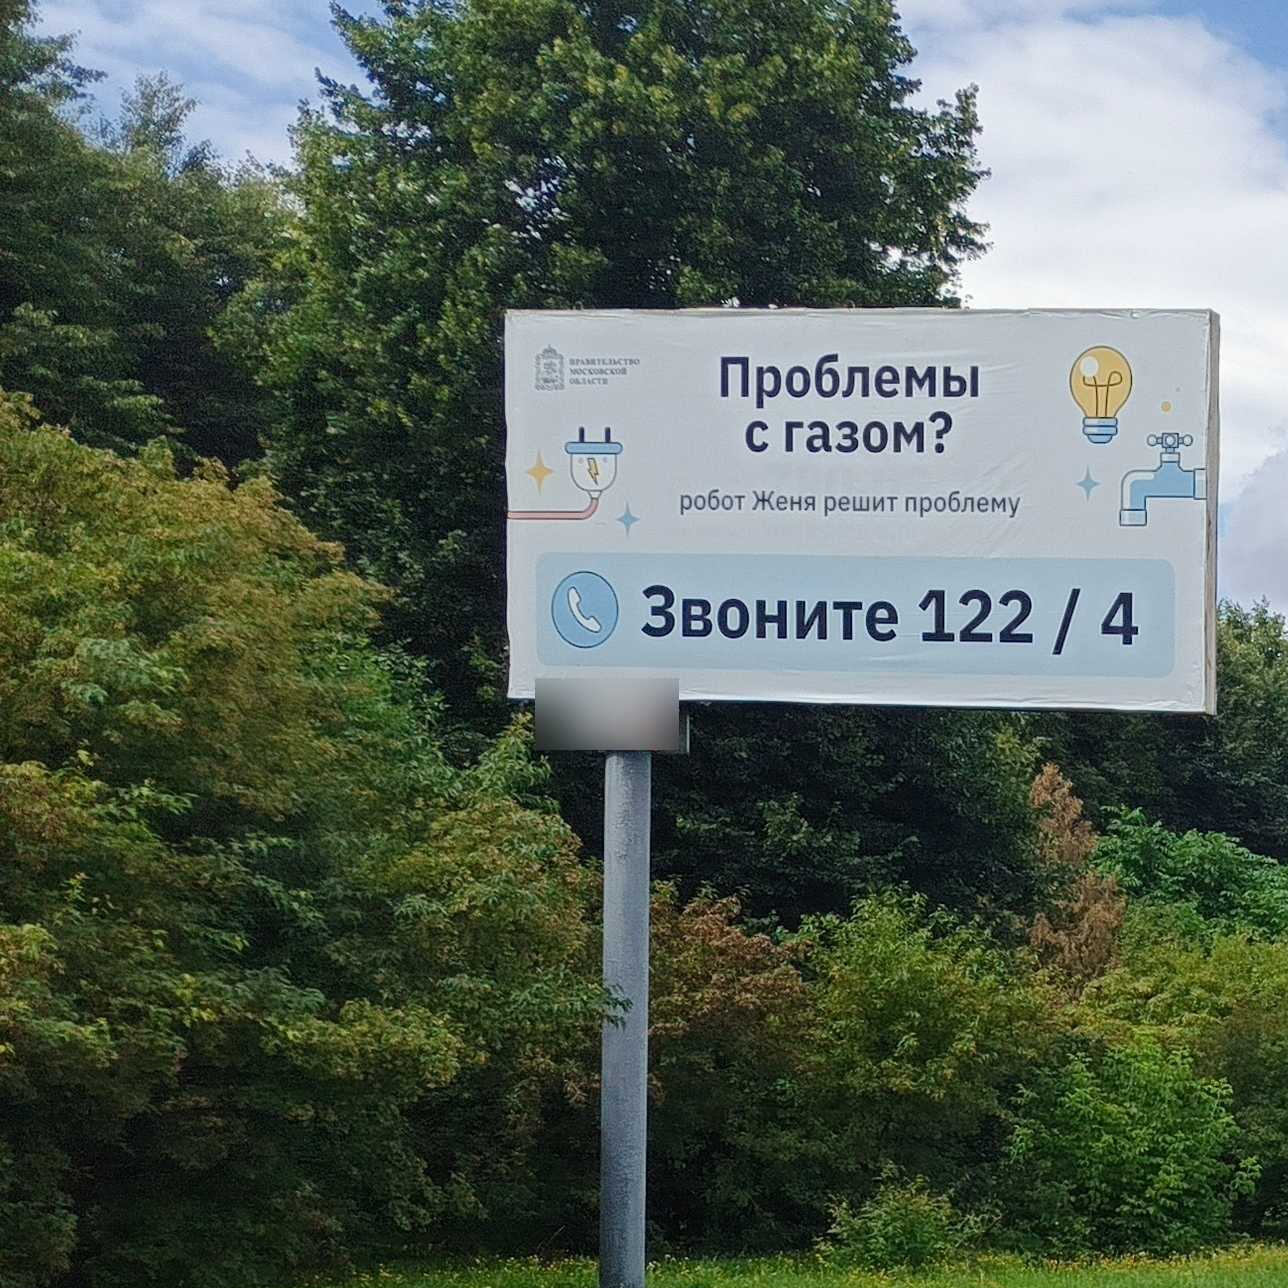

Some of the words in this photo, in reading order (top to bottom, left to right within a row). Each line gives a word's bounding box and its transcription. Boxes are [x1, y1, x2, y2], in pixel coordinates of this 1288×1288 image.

[719, 353, 980, 409] Проблемы
[744, 420, 769, 453] с
[784, 410, 953, 454] газом?
[679, 489, 745, 516] робот
[751, 491, 816, 512] Женя
[823, 494, 898, 517] решит
[904, 491, 1022, 518] проблему
[640, 584, 899, 642] Звоните
[918, 588, 1034, 644] 122
[1051, 587, 1081, 655] /
[1100, 591, 1140, 645] 4
